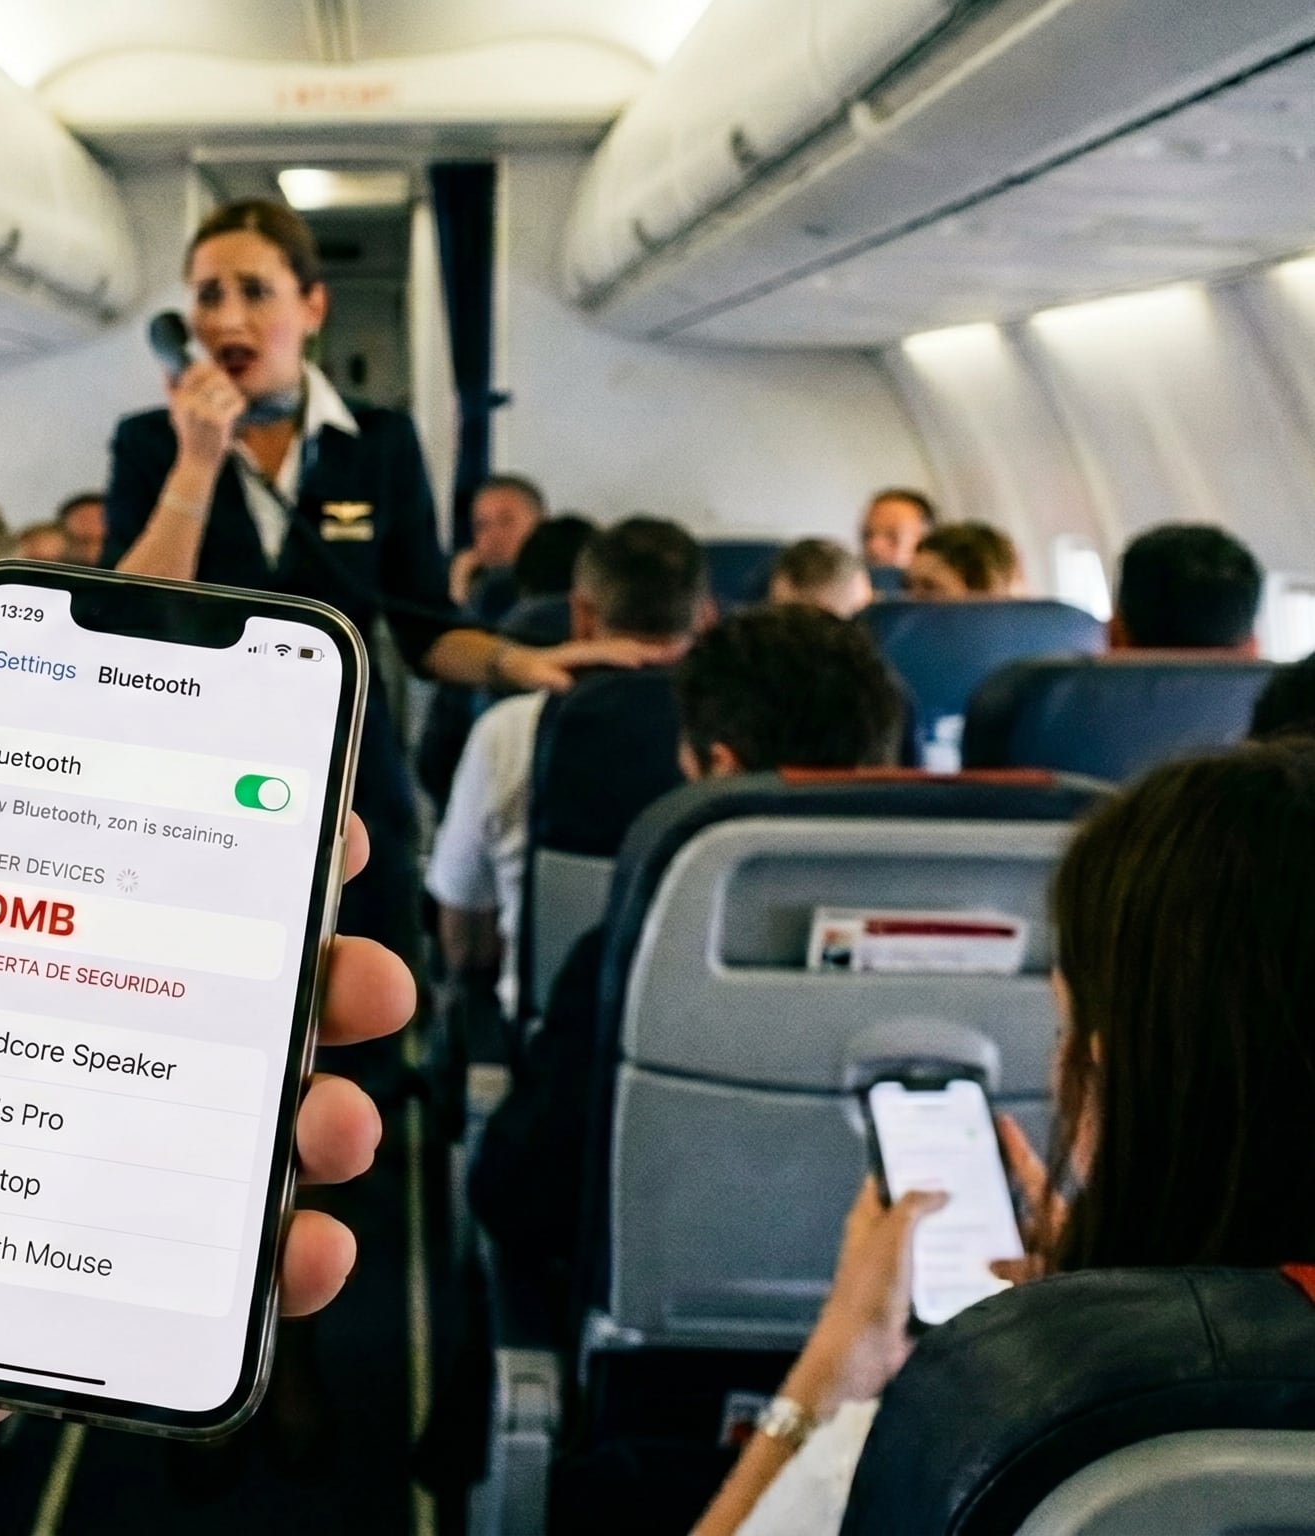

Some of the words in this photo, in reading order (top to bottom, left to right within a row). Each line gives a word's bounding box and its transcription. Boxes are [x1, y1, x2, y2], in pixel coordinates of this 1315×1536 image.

[1, 604, 44, 622] 13:29
[98, 666, 200, 697] Bluetooth
[13, 800, 100, 830] Bluetooth,
[108, 817, 137, 832] zon
[143, 818, 156, 834] is
[162, 825, 238, 849] scaining.
[26, 858, 105, 884] DEVICES
[46, 963, 71, 981] DE
[76, 968, 185, 998] SEGURIDAD
[73, 1044, 177, 1080] Speaker
[22, 1104, 63, 1130] Pro
[26, 1241, 112, 1276] Mouse
